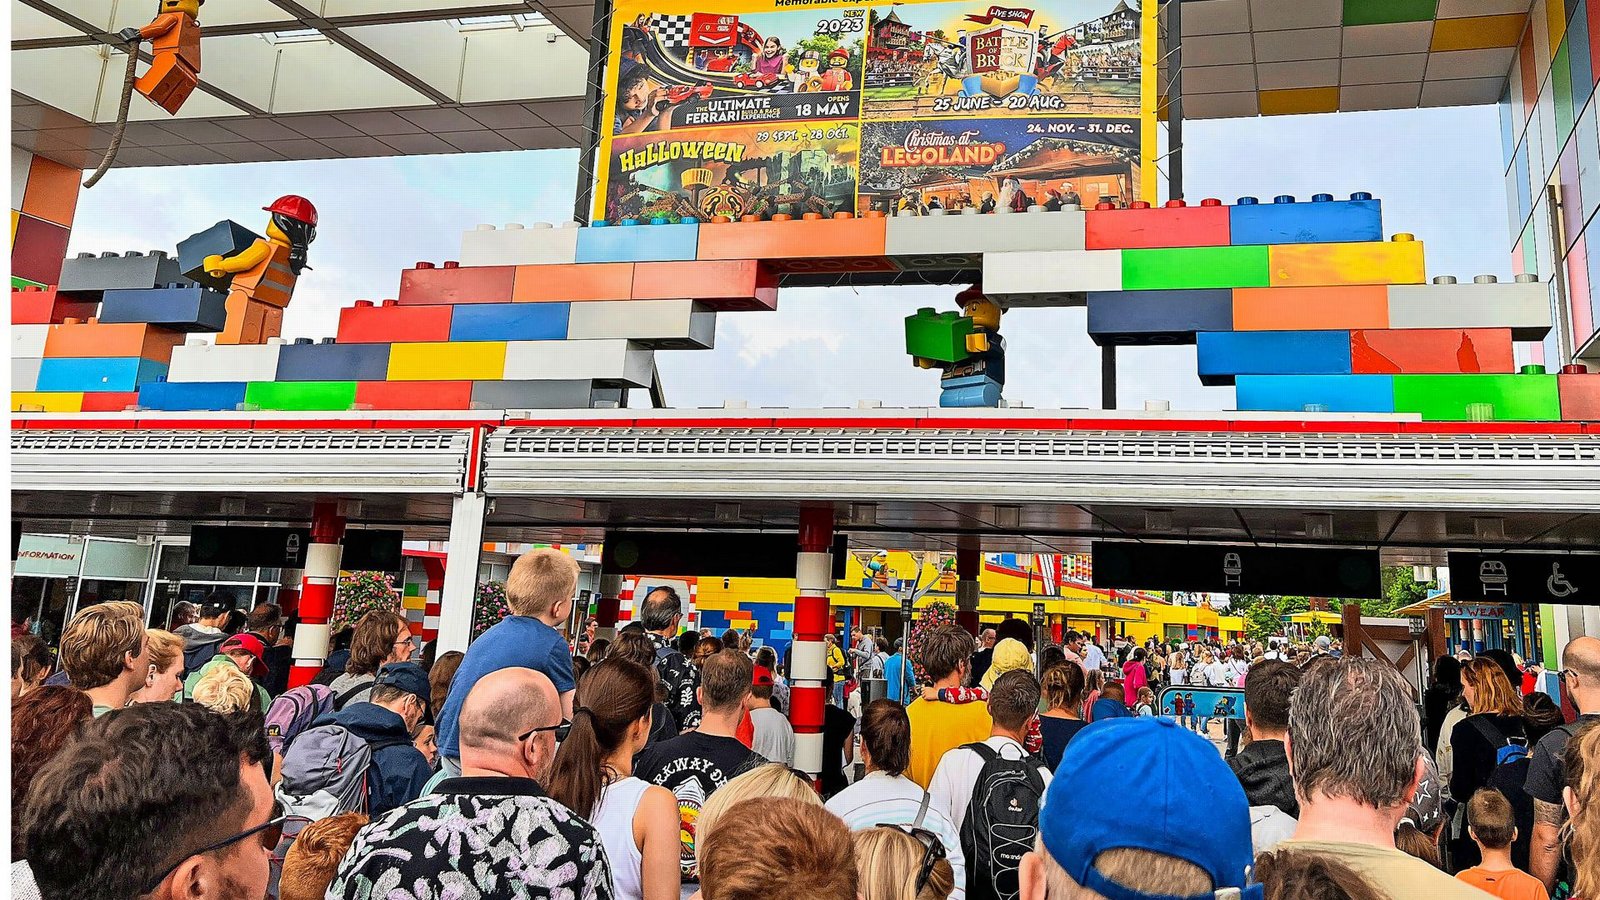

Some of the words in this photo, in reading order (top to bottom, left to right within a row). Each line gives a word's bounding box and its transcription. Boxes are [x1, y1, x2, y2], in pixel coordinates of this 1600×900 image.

[990, 9, 1006, 17] LIVE
[1008, 11, 1030, 19] SHOW
[818, 19, 863, 33] 2023
[976, 36, 1028, 50] BATTLE
[976, 53, 1026, 68] BRICK
[708, 98, 771, 111] ULTIMATE
[828, 95, 849, 103] OPENS
[934, 98, 951, 110] 25
[953, 97, 990, 110] JUNE
[1008, 96, 1026, 109] 20
[1029, 96, 1064, 109] AUG.
[795, 104, 811, 116] 18
[816, 102, 850, 116] MAY
[686, 111, 740, 124] FERRARI
[757, 131, 769, 141] 29
[772, 130, 798, 141] SEPT.
[810, 129, 823, 139] 28
[826, 128, 849, 139] OCT.
[1027, 124, 1045, 133] 24.
[1048, 124, 1075, 133] NOV.
[1087, 124, 1103, 133] 31.
[1106, 124, 1134, 133] DEC.
[904, 129, 955, 152] Christmas
[958, 130, 980, 146] at
[17, 550, 75, 560] NFORMATION
[1467, 608, 1505, 617] WEAR
[653, 757, 714, 786] RKWAY
